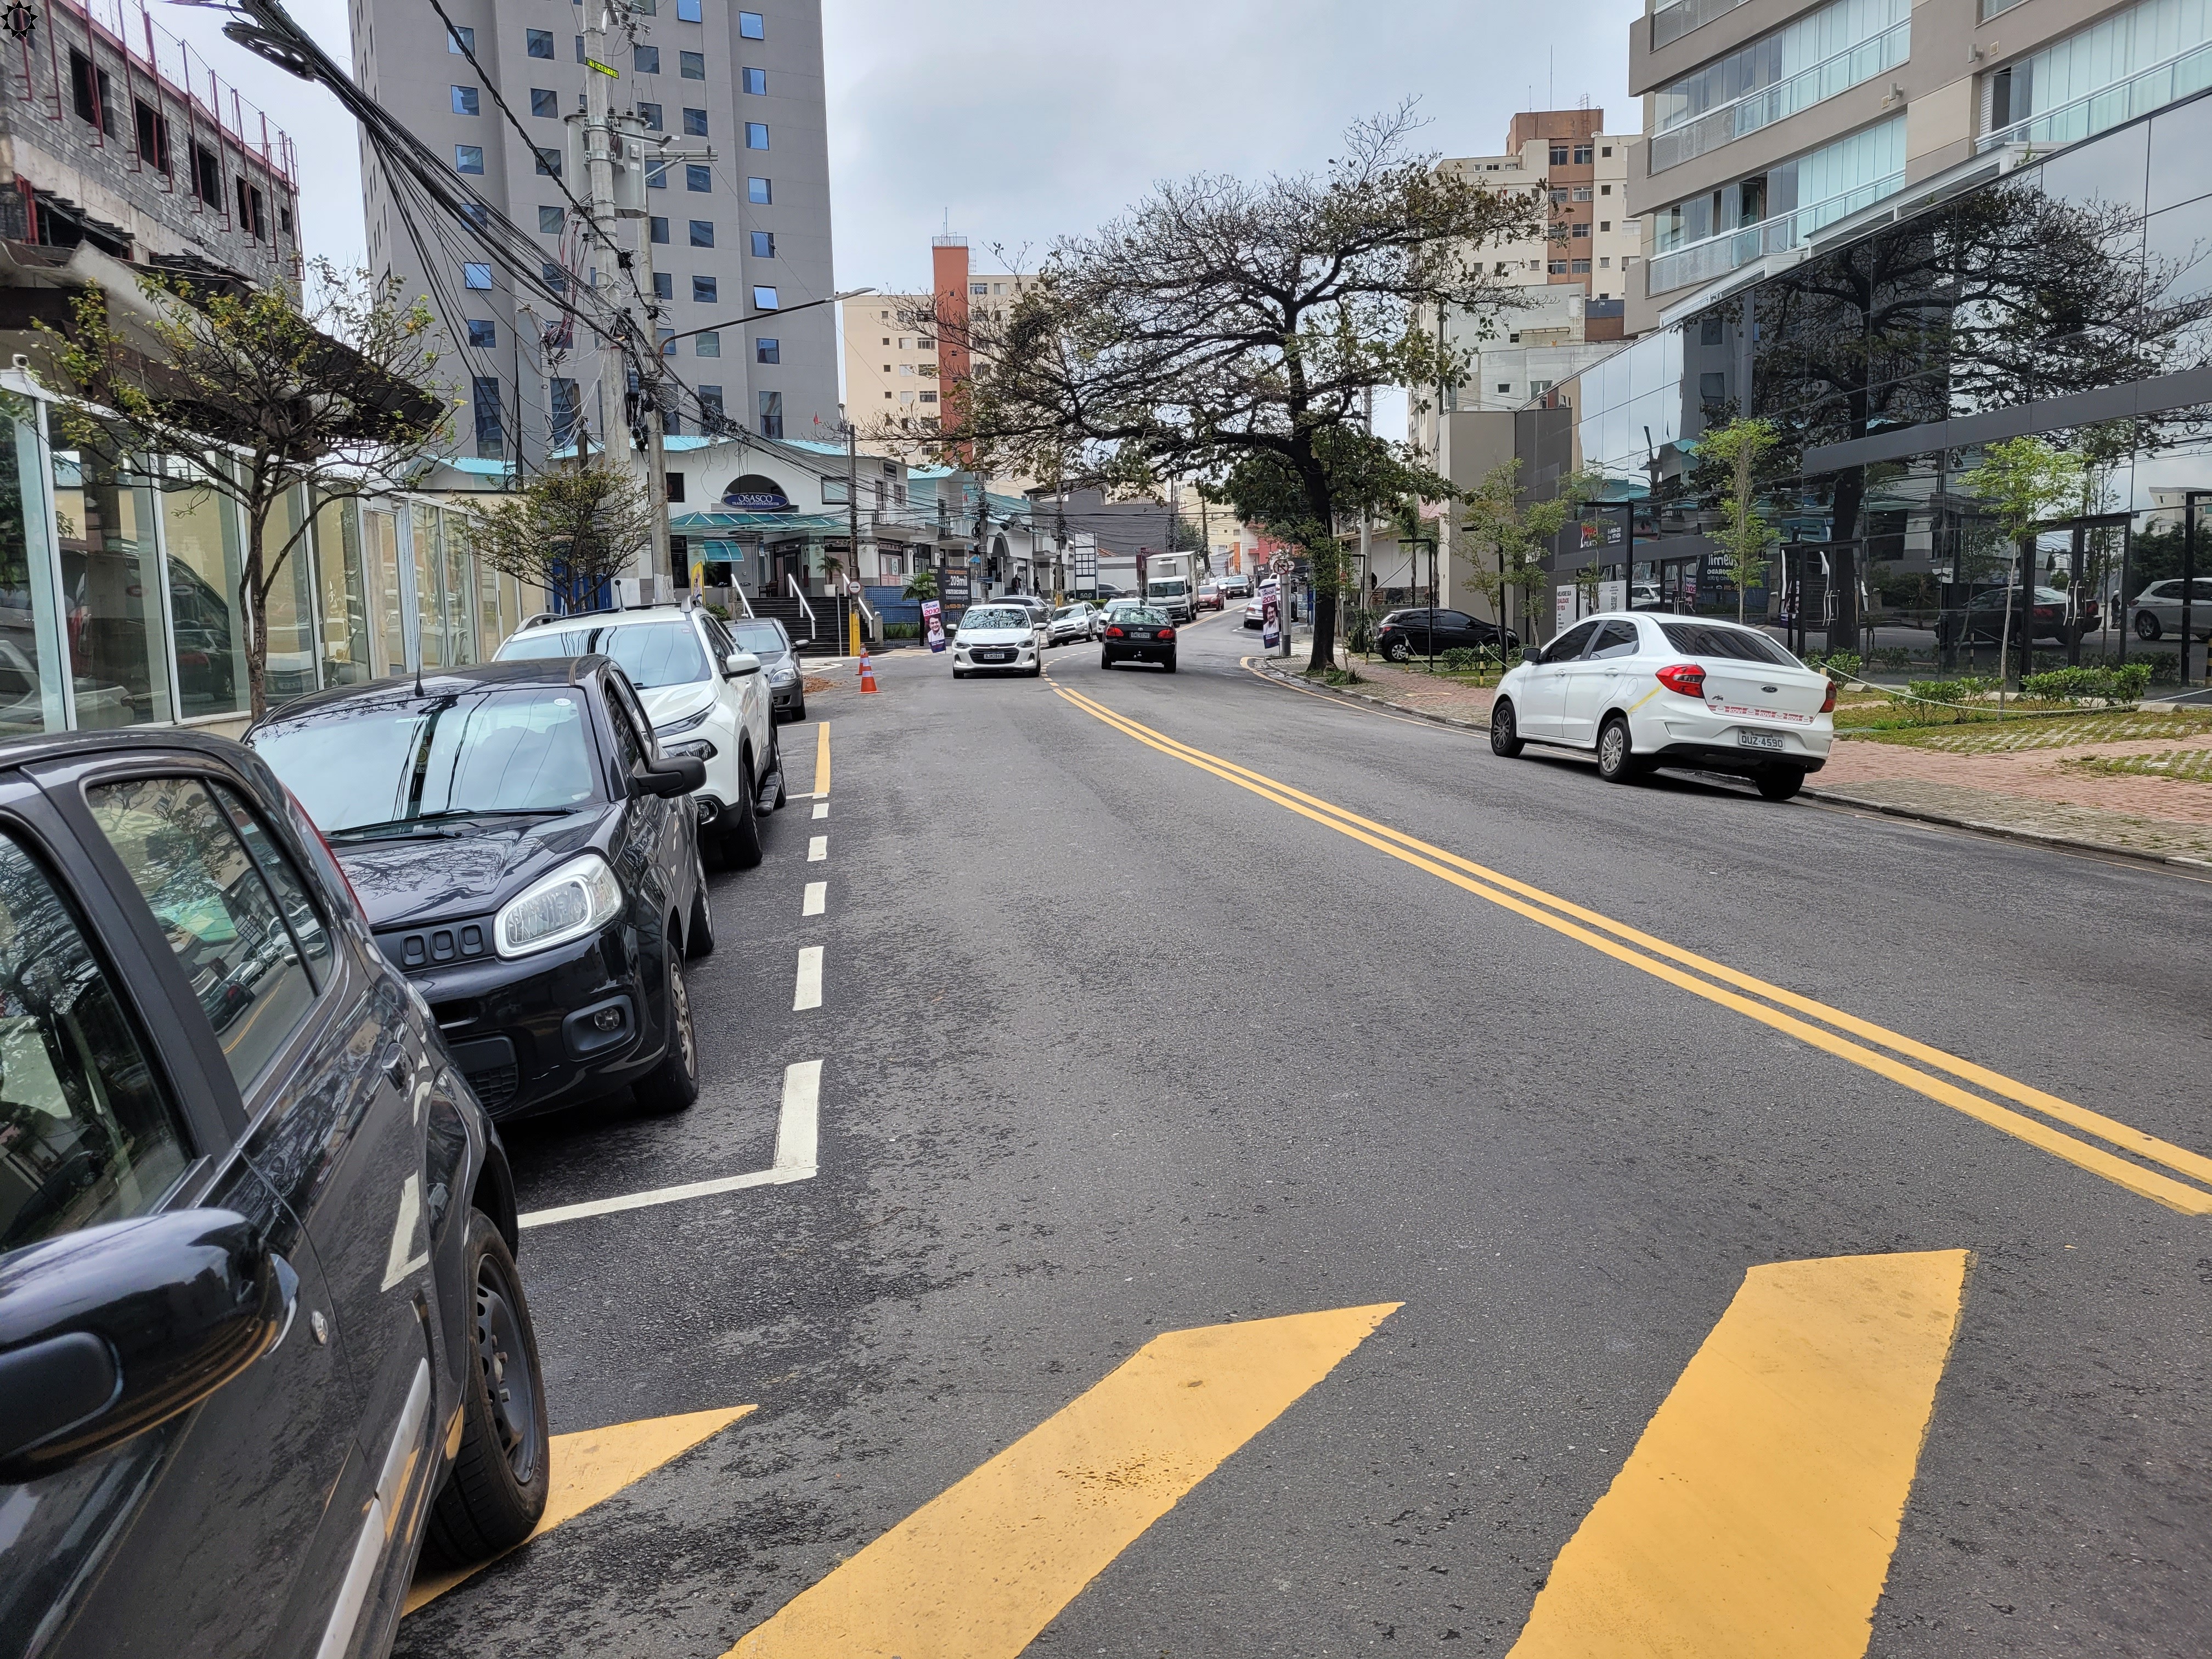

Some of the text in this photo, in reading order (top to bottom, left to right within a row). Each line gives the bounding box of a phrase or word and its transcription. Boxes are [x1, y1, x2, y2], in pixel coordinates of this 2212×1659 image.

[950, 575, 968, 586] 209mil
[1263, 595, 1276, 603] 2010
[1759, 709, 1773, 718] kovi
[1787, 713, 1800, 721] kovi
